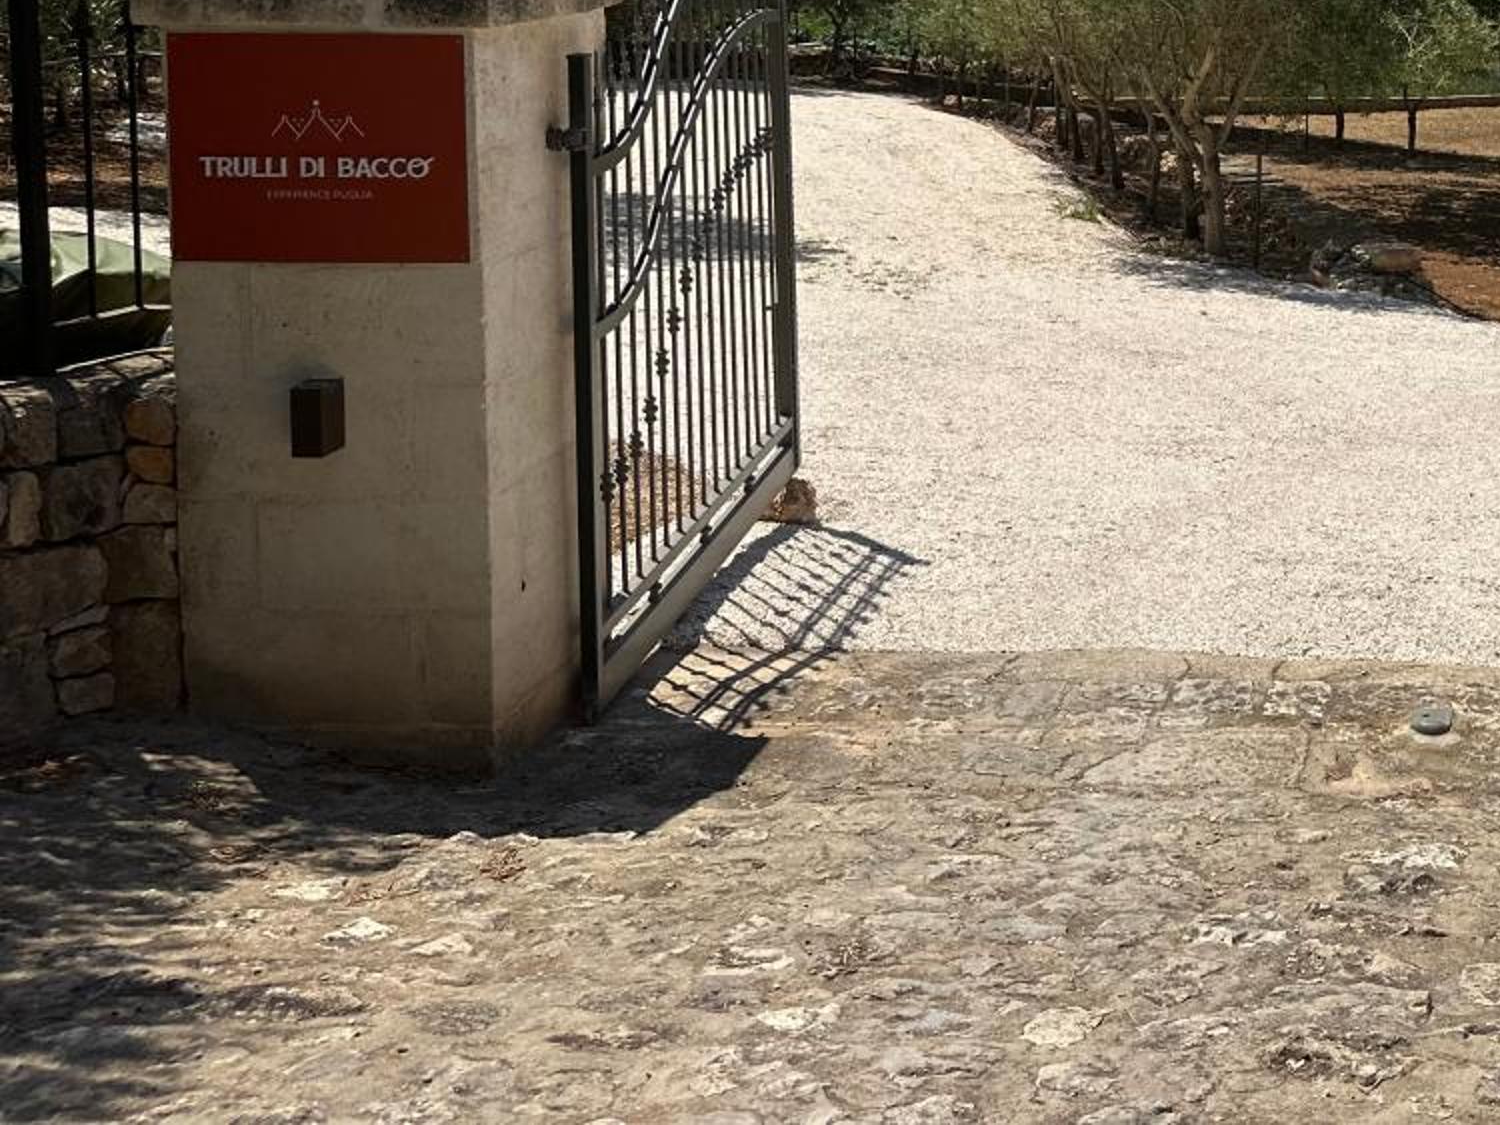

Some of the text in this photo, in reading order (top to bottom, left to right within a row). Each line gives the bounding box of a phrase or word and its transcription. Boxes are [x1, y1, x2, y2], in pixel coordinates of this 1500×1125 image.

[199, 156, 435, 178] TRULLI DI BACCO
